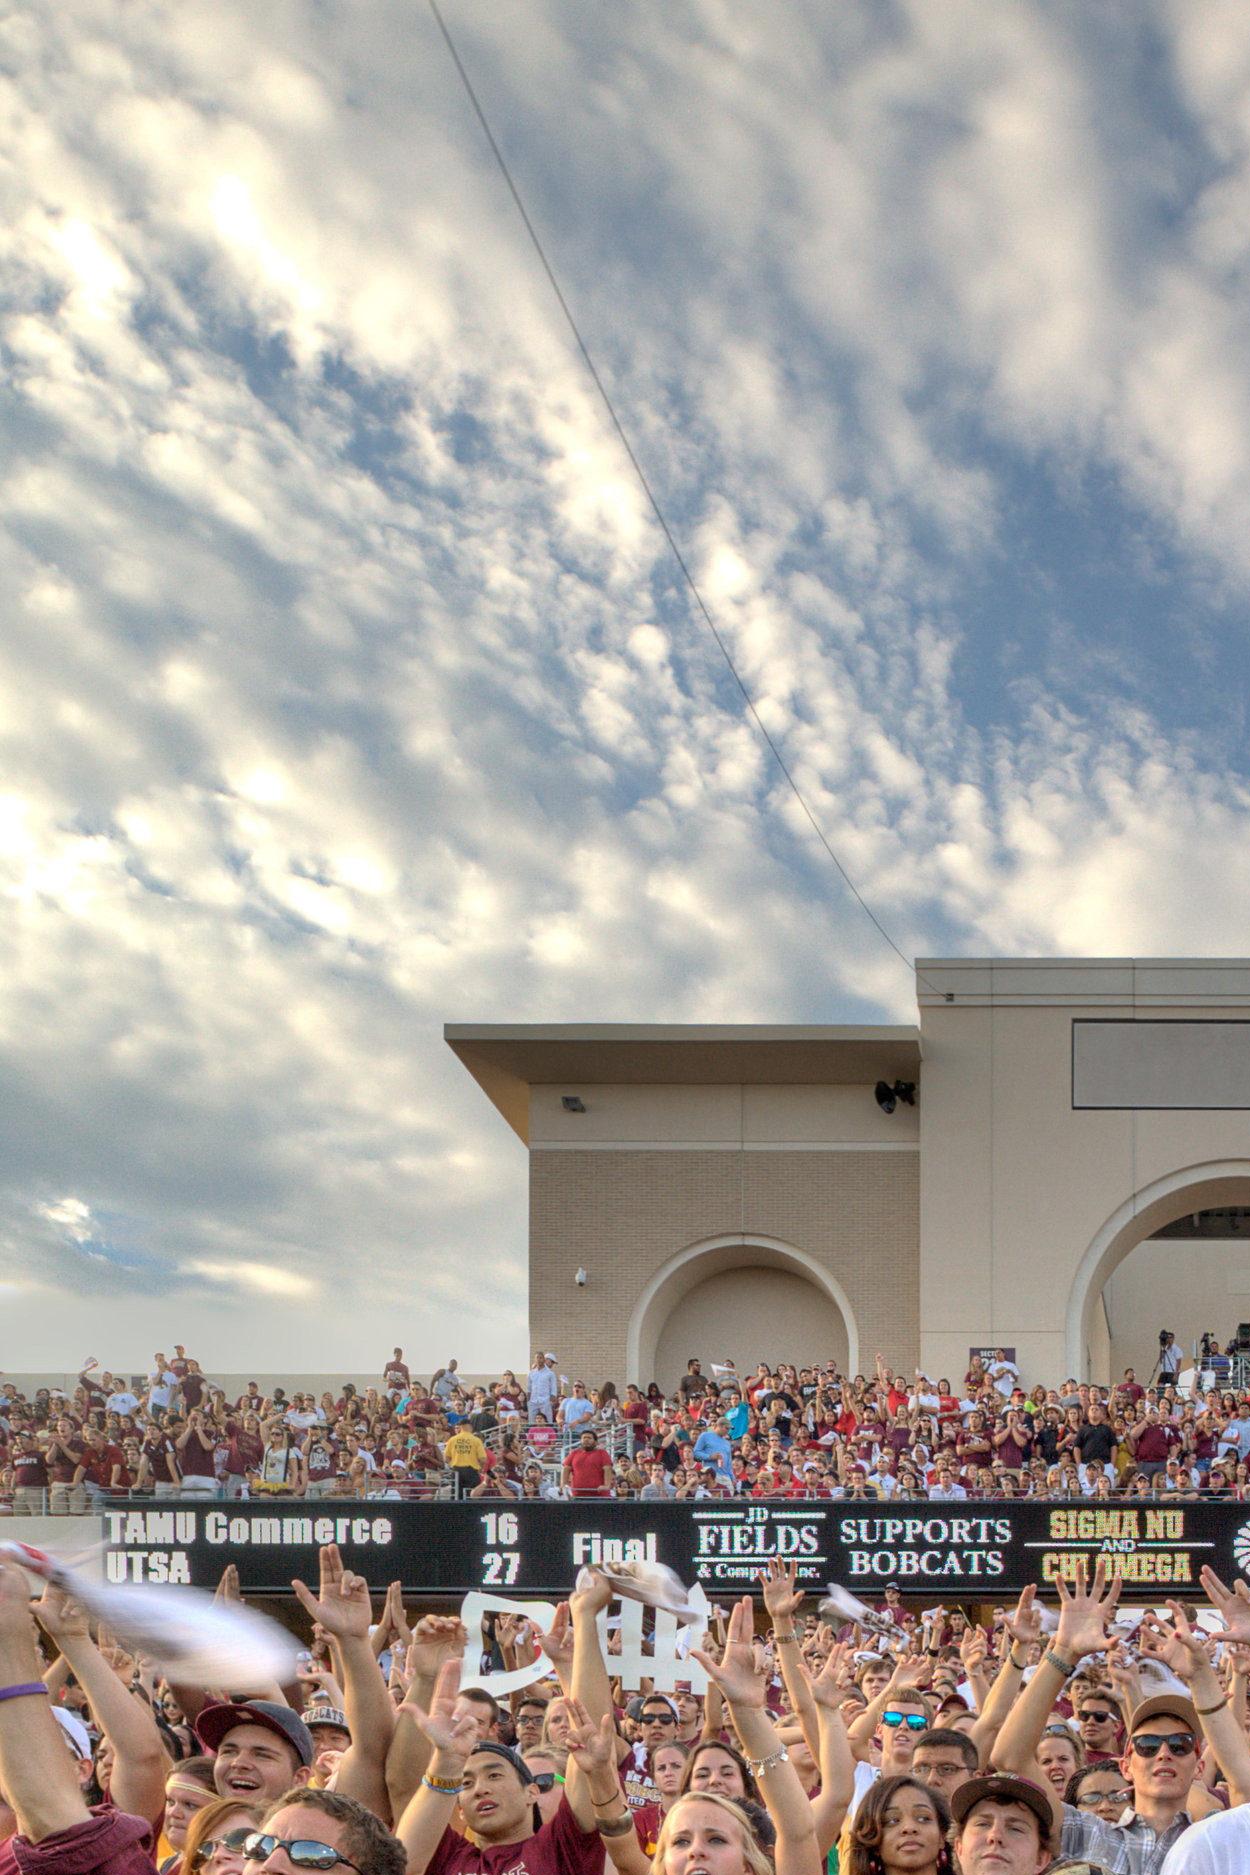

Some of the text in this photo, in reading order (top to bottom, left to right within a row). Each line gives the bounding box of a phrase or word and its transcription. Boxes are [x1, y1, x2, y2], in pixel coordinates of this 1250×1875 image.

[105, 1511, 519, 1545] TAMU Commerce 16
[745, 1507, 769, 1523] JD
[1049, 1510, 1184, 1539] SIGMA NU
[698, 1525, 819, 1555] FIELDS
[841, 1518, 1012, 1544] SUPPORTS
[1101, 1539, 1137, 1552] AND
[573, 1533, 657, 1566] Final
[849, 1550, 1004, 1576] BOBCATS
[106, 1550, 520, 1585] UTSA 27
[697, 1563, 711, 1578] &
[1042, 1553, 1192, 1582] CHI OMEGA
